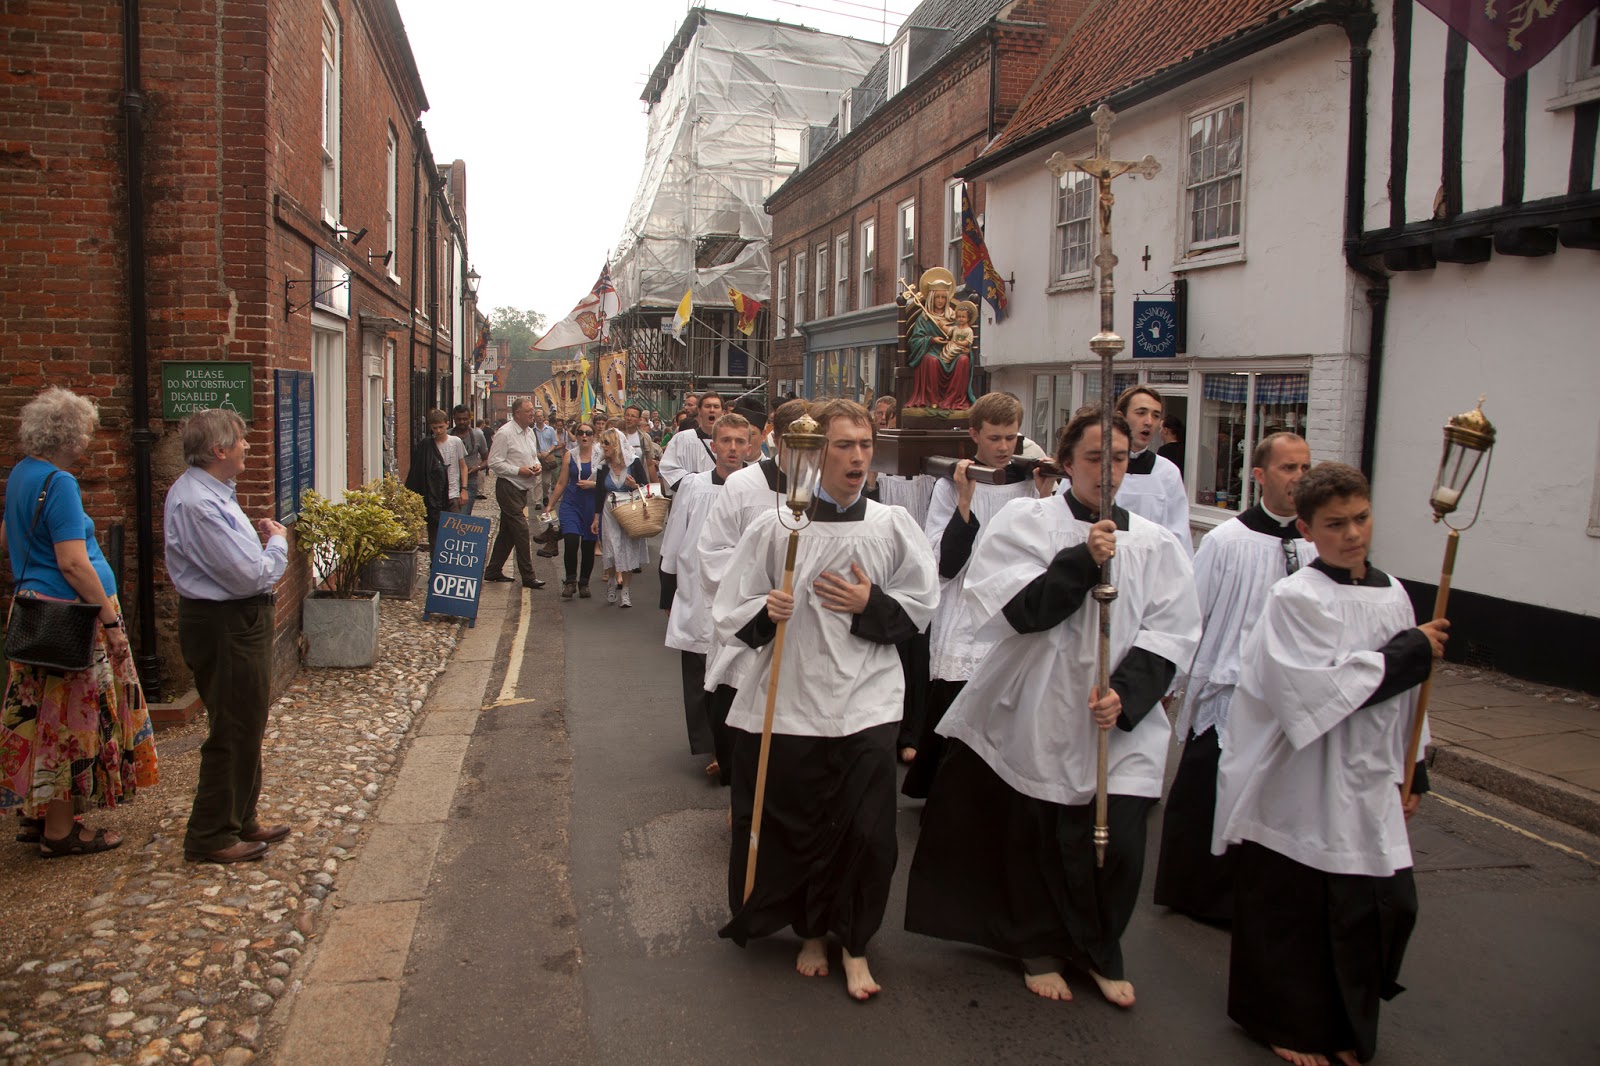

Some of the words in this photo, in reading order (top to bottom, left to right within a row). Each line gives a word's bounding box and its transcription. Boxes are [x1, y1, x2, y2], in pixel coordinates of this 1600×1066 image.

[1135, 306, 1175, 329] WALSINGHAM
[1136, 331, 1175, 354] TEAROOMS
[185, 369, 225, 379] PLEASE
[167, 379, 180, 389] DO
[181, 379, 200, 389] NOT
[200, 379, 246, 389] OBSTRUCT
[171, 391, 218, 402] DISABLED
[173, 403, 210, 413] ACCESS
[442, 516, 484, 537] Pilgrim
[444, 538, 478, 554] GIFT
[438, 550, 479, 568] SHOP
[433, 575, 478, 599] OPEN
